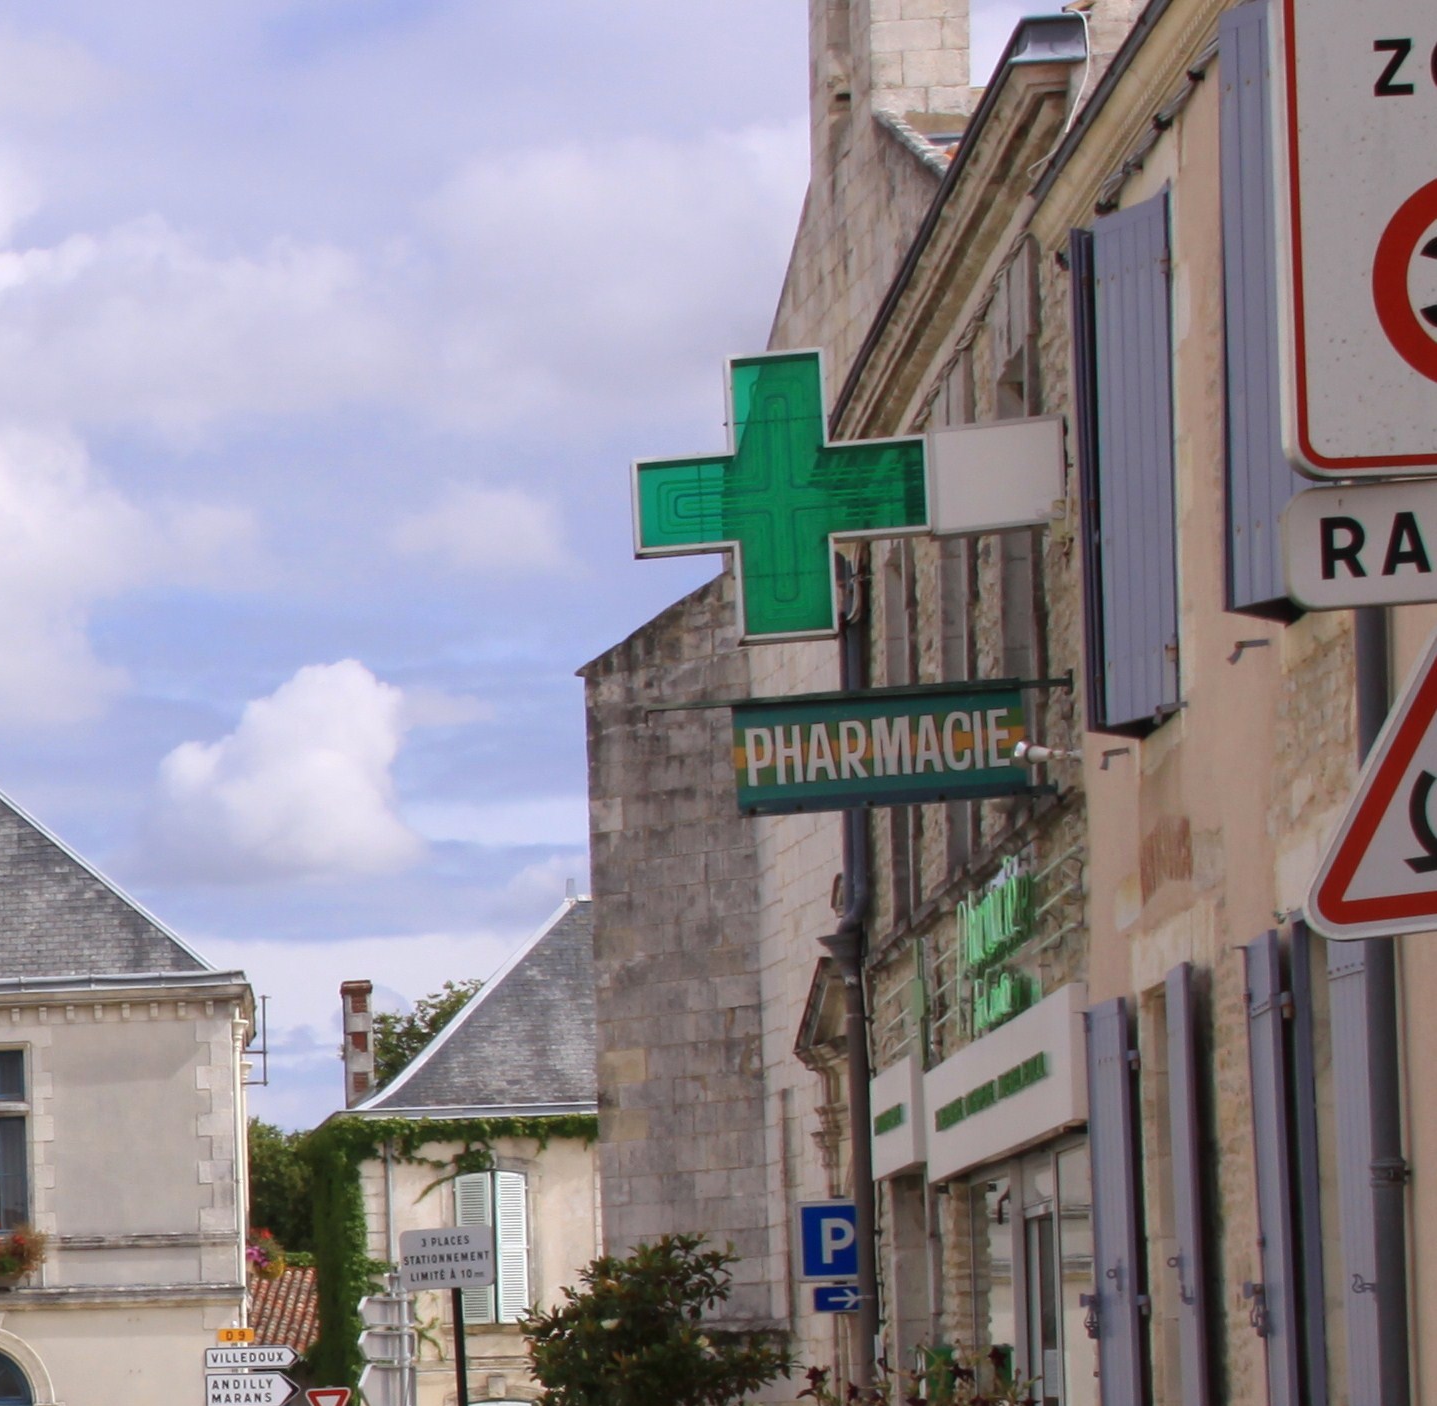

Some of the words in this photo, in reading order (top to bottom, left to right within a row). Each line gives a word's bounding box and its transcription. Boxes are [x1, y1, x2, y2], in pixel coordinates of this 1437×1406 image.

[1373, 38, 1437, 97] Z
[744, 708, 1011, 787] PHARMACIE
[421, 1238, 427, 1248] 3
[431, 1235, 470, 1247] PLACES
[820, 1218, 854, 1264] P
[403, 1250, 489, 1266] STATIONNEMENT
[410, 1268, 445, 1282] LIMITÉ
[461, 1269, 473, 1279] 10
[226, 1331, 233, 1341] D
[238, 1331, 246, 1341] 9
[211, 1353, 284, 1364] VILLEDOUX
[212, 1379, 273, 1390] ANDILLY
[212, 1393, 272, 1404] MARANS
